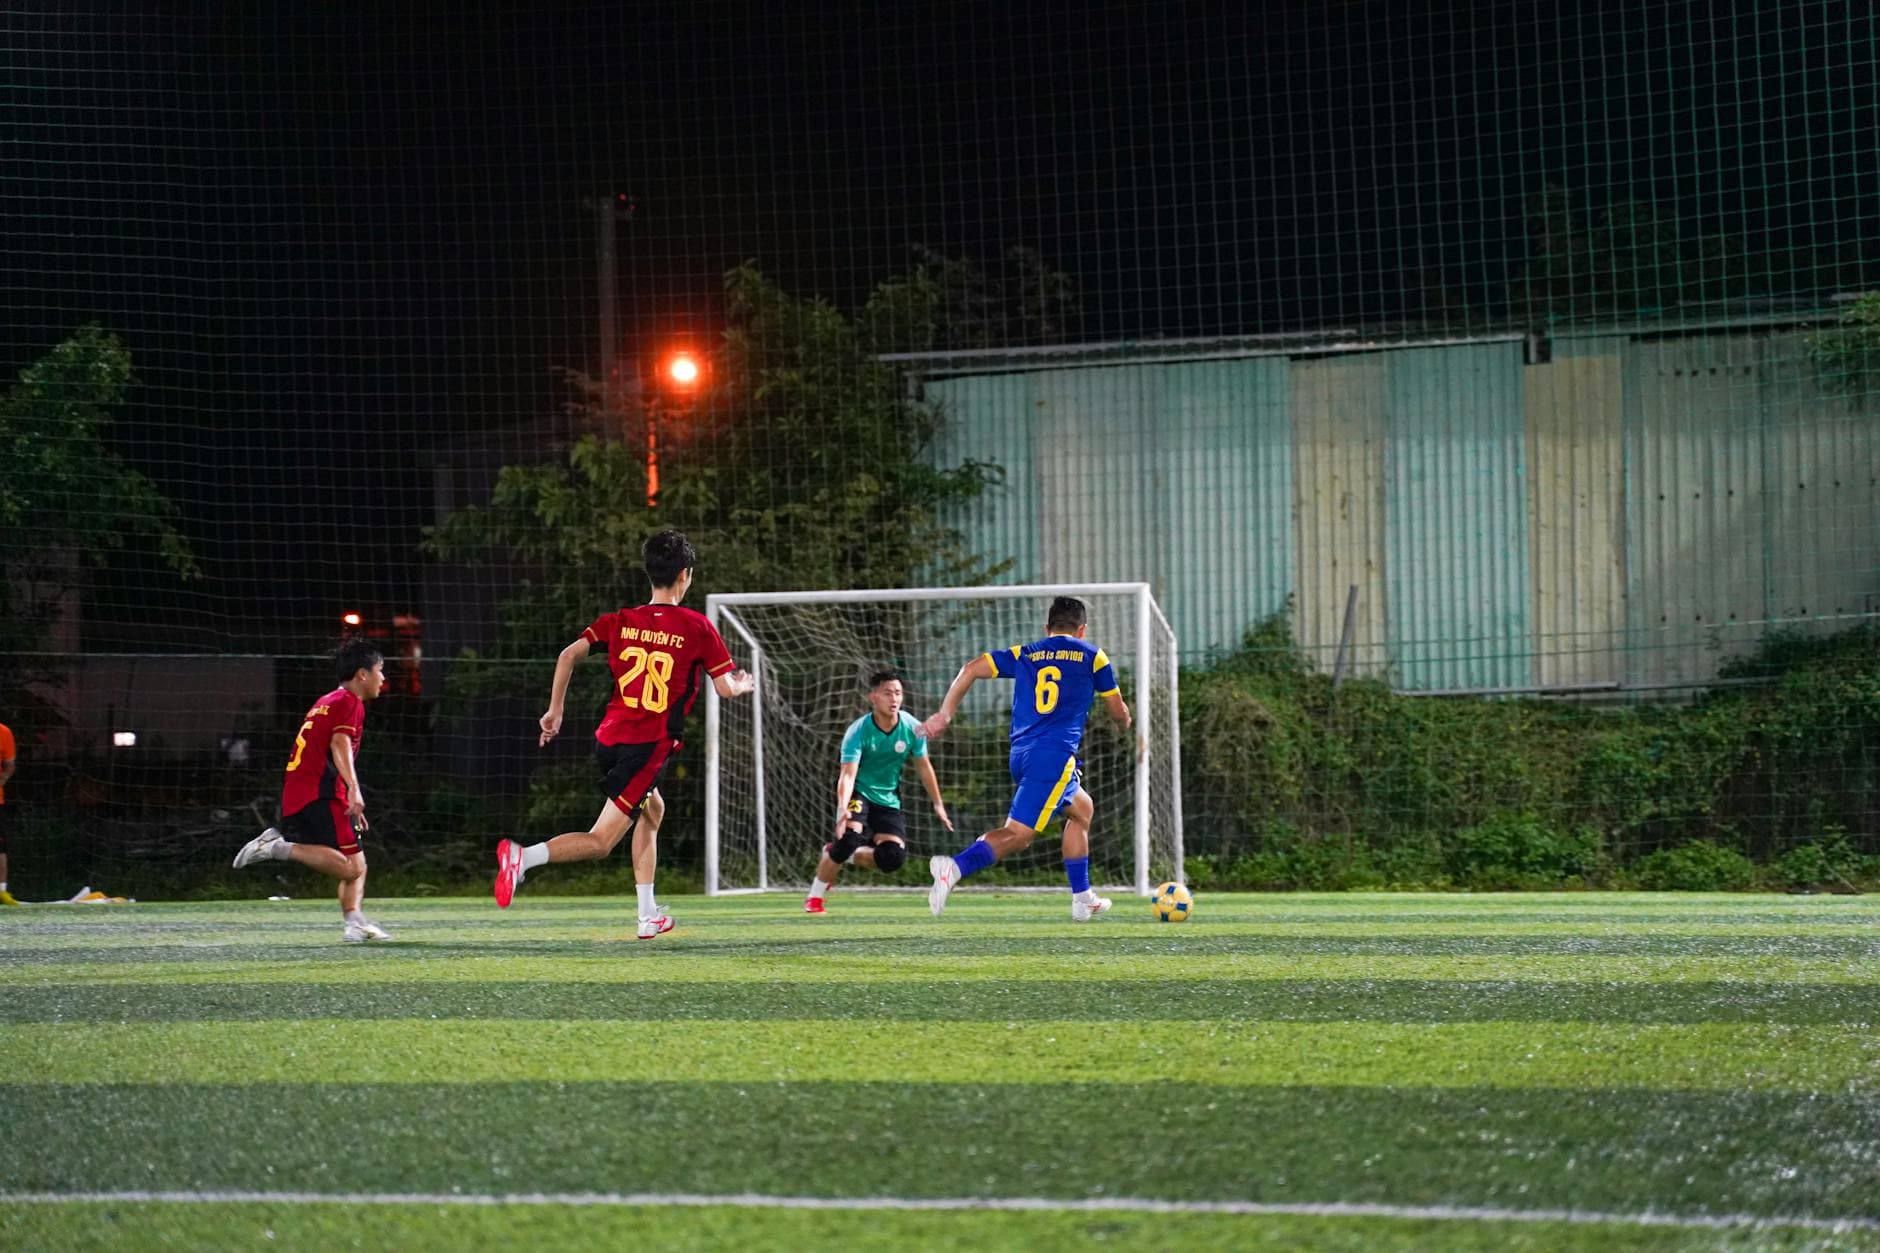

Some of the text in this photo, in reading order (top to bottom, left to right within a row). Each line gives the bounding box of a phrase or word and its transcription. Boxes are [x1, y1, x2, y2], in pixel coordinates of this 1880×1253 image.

[669, 634, 685, 649] FC
[618, 646, 675, 714] 28
[1035, 665, 1062, 715] 6
